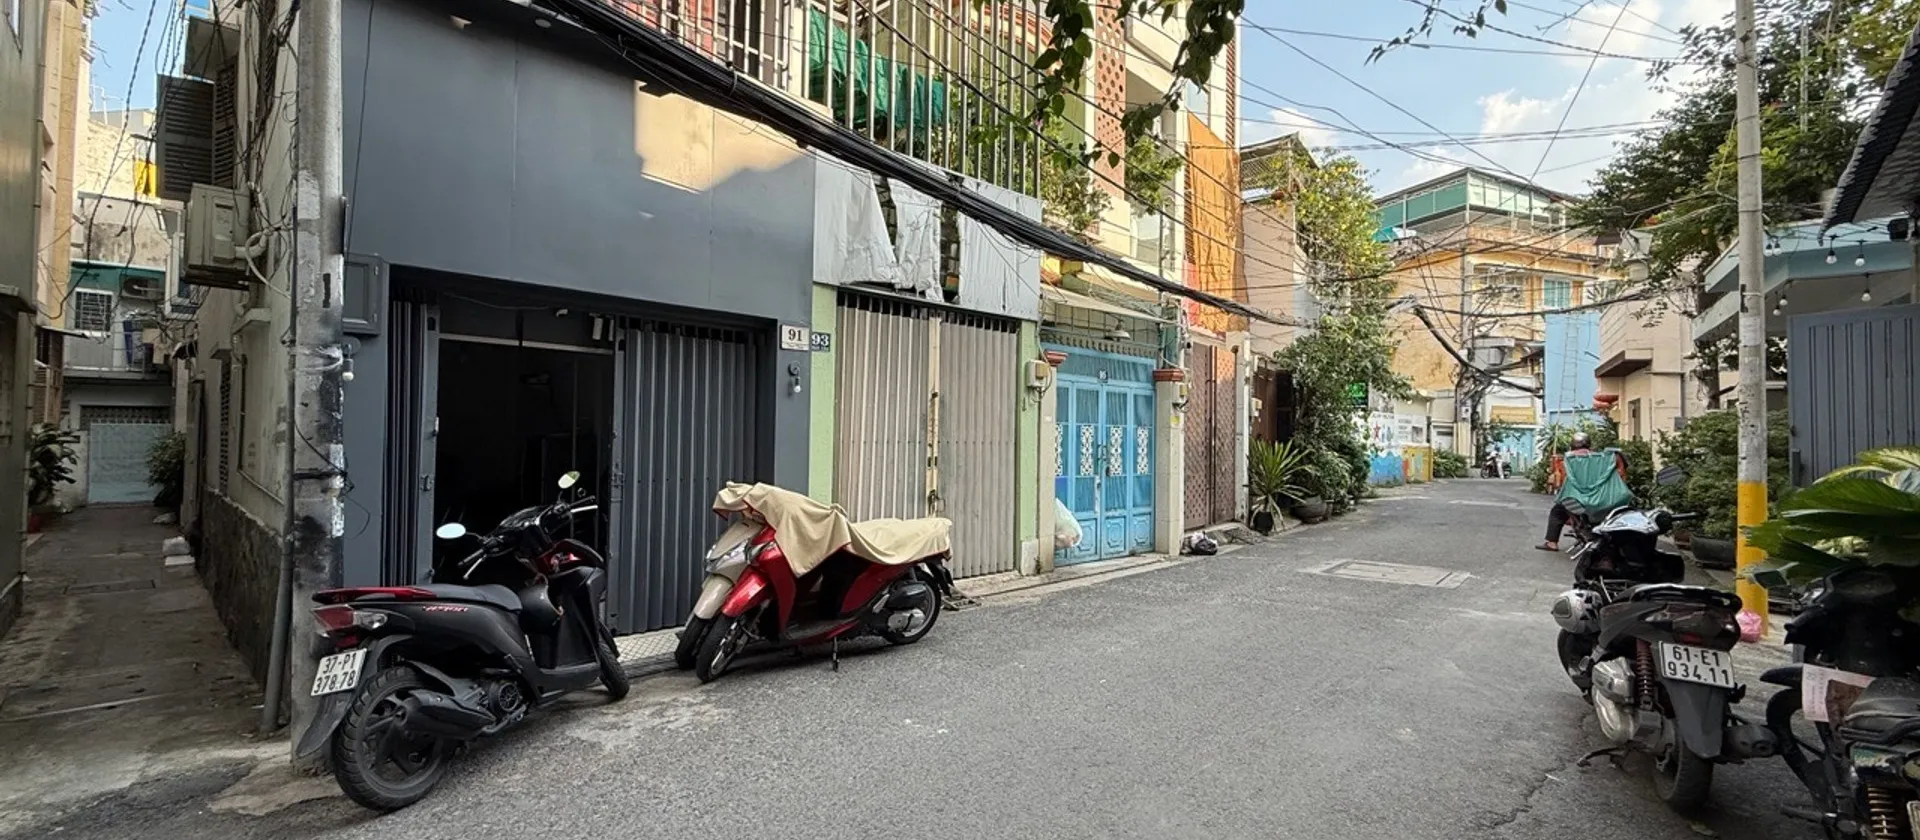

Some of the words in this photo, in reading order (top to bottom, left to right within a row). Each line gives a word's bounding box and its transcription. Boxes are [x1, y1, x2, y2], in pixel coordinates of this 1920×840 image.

[788, 329, 802, 341] 91
[811, 333, 829, 347] 93
[323, 652, 357, 674] 37-P1
[1673, 646, 1719, 667] 61-E1
[314, 670, 356, 694] 378.78
[1668, 661, 1729, 685] 934.11
